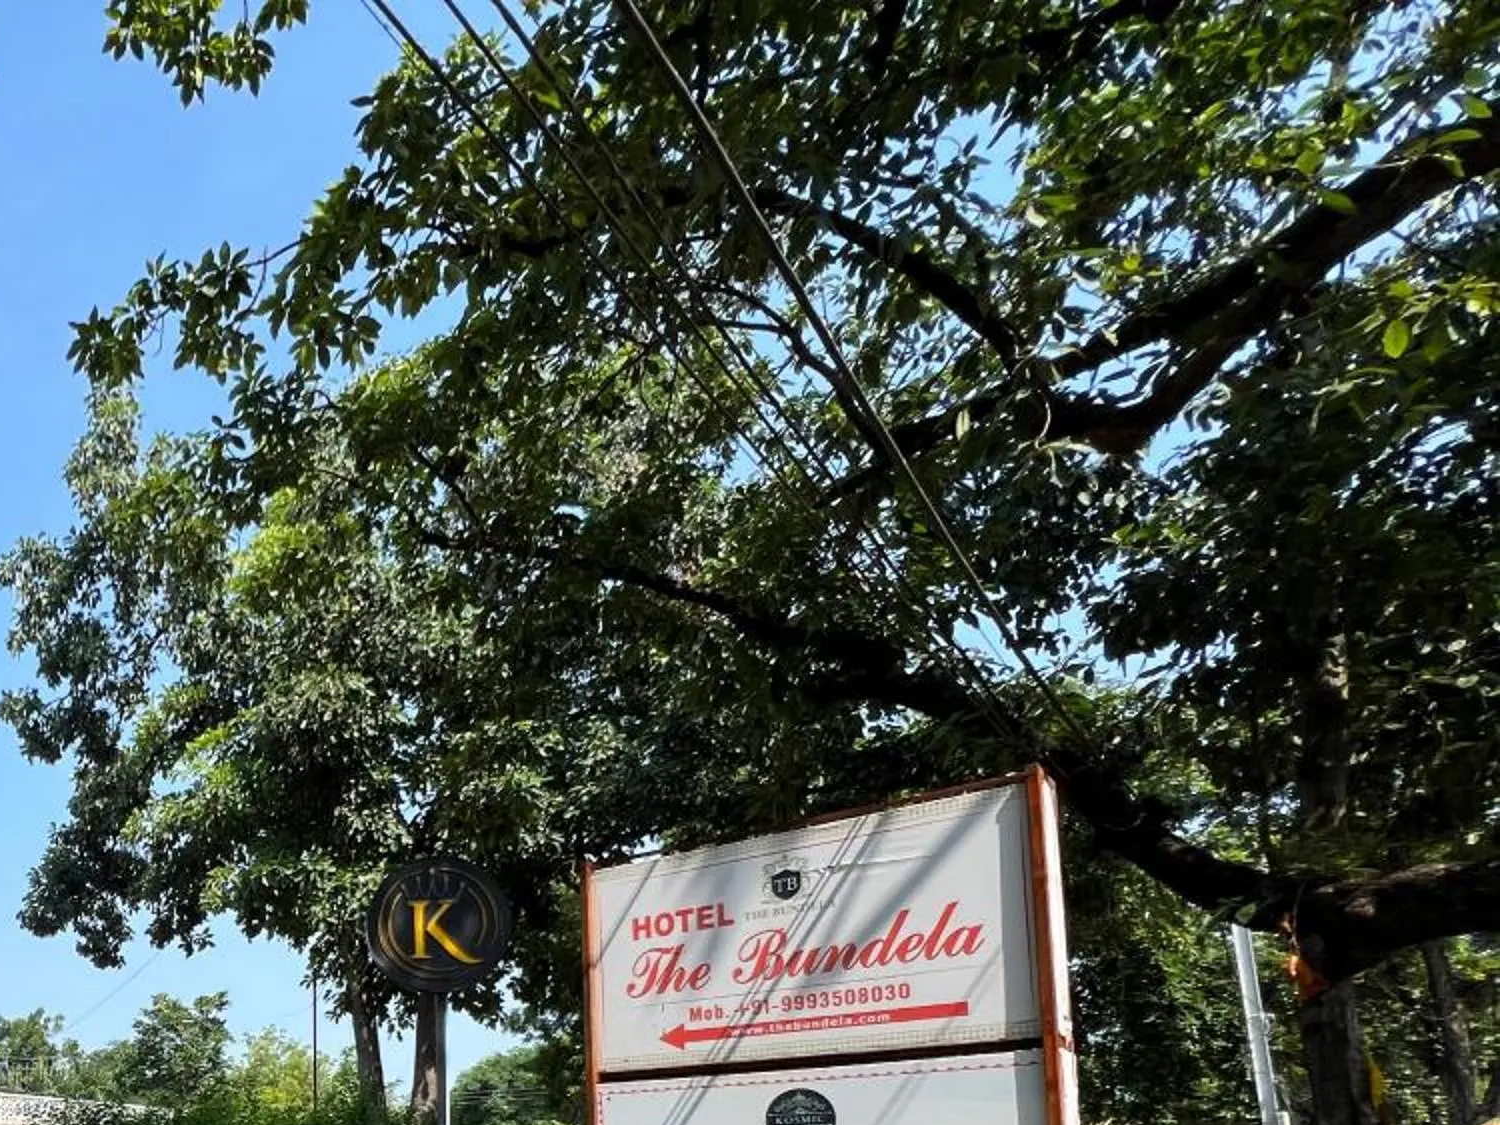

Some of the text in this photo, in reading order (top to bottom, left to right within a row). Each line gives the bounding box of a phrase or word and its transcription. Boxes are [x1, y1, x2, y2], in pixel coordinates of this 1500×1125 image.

[774, 877, 799, 894] TB
[631, 903, 735, 942] HOTEL
[625, 901, 984, 999] The Bundela
[689, 1005, 731, 1022] Mob.
